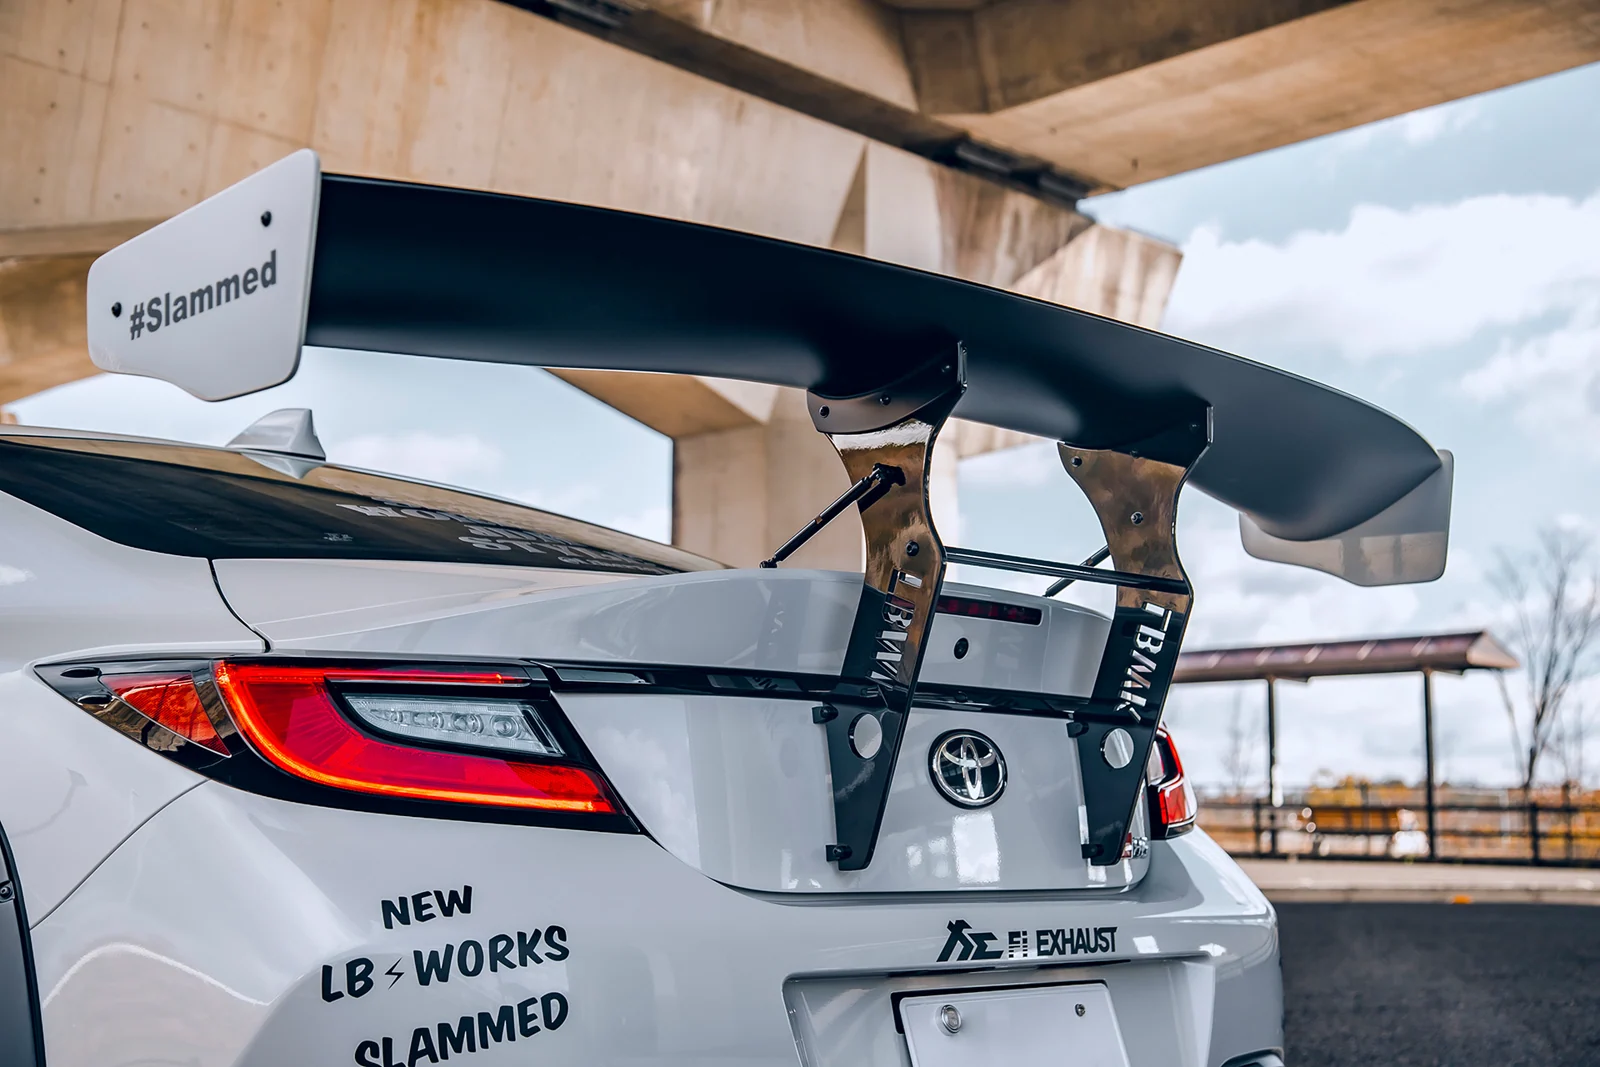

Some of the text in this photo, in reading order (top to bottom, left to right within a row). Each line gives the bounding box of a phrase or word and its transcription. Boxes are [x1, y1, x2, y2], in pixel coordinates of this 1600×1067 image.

[129, 249, 277, 341] #Slammed
[381, 885, 473, 930] NEW
[1036, 926, 1118, 957] EXHAUST
[321, 925, 569, 1002] LB WORKS
[354, 992, 568, 1067] SLAMMED
